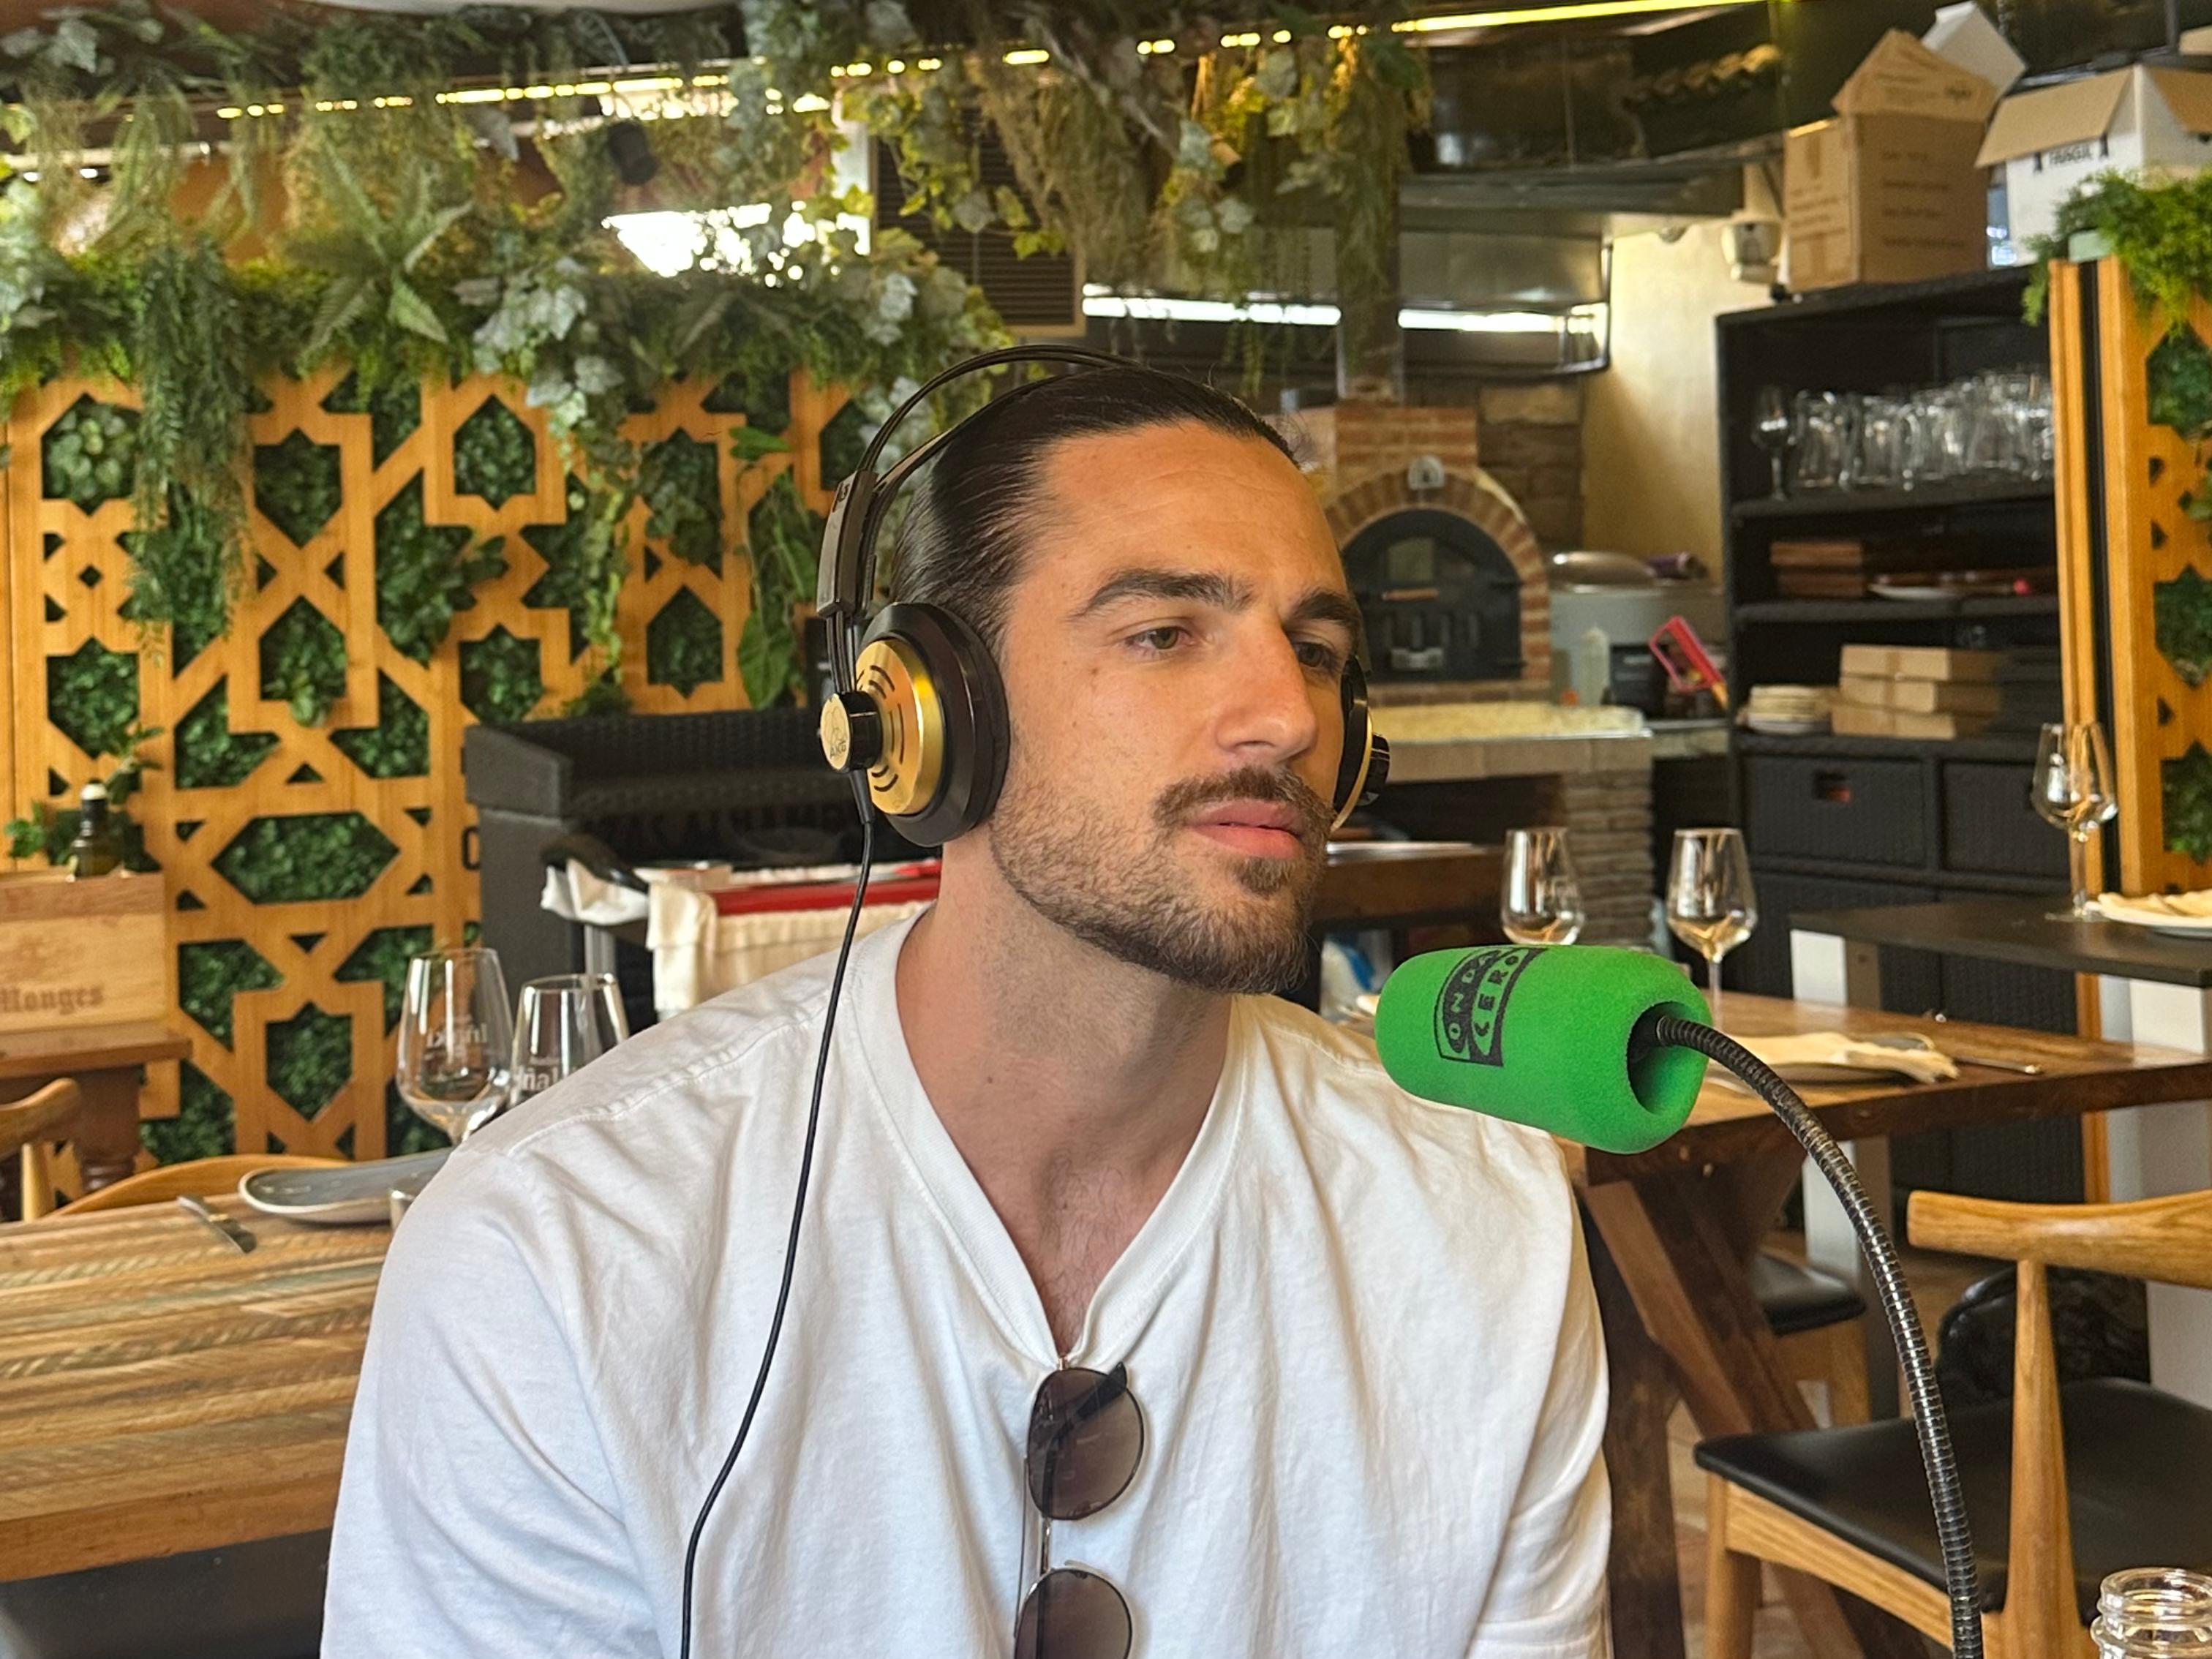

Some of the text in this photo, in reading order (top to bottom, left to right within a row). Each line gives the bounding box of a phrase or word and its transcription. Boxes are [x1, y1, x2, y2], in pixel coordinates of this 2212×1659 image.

[830, 740, 847, 759] AKG
[1449, 955, 1495, 1040] ONDA
[1473, 955, 1519, 1037] CERO
